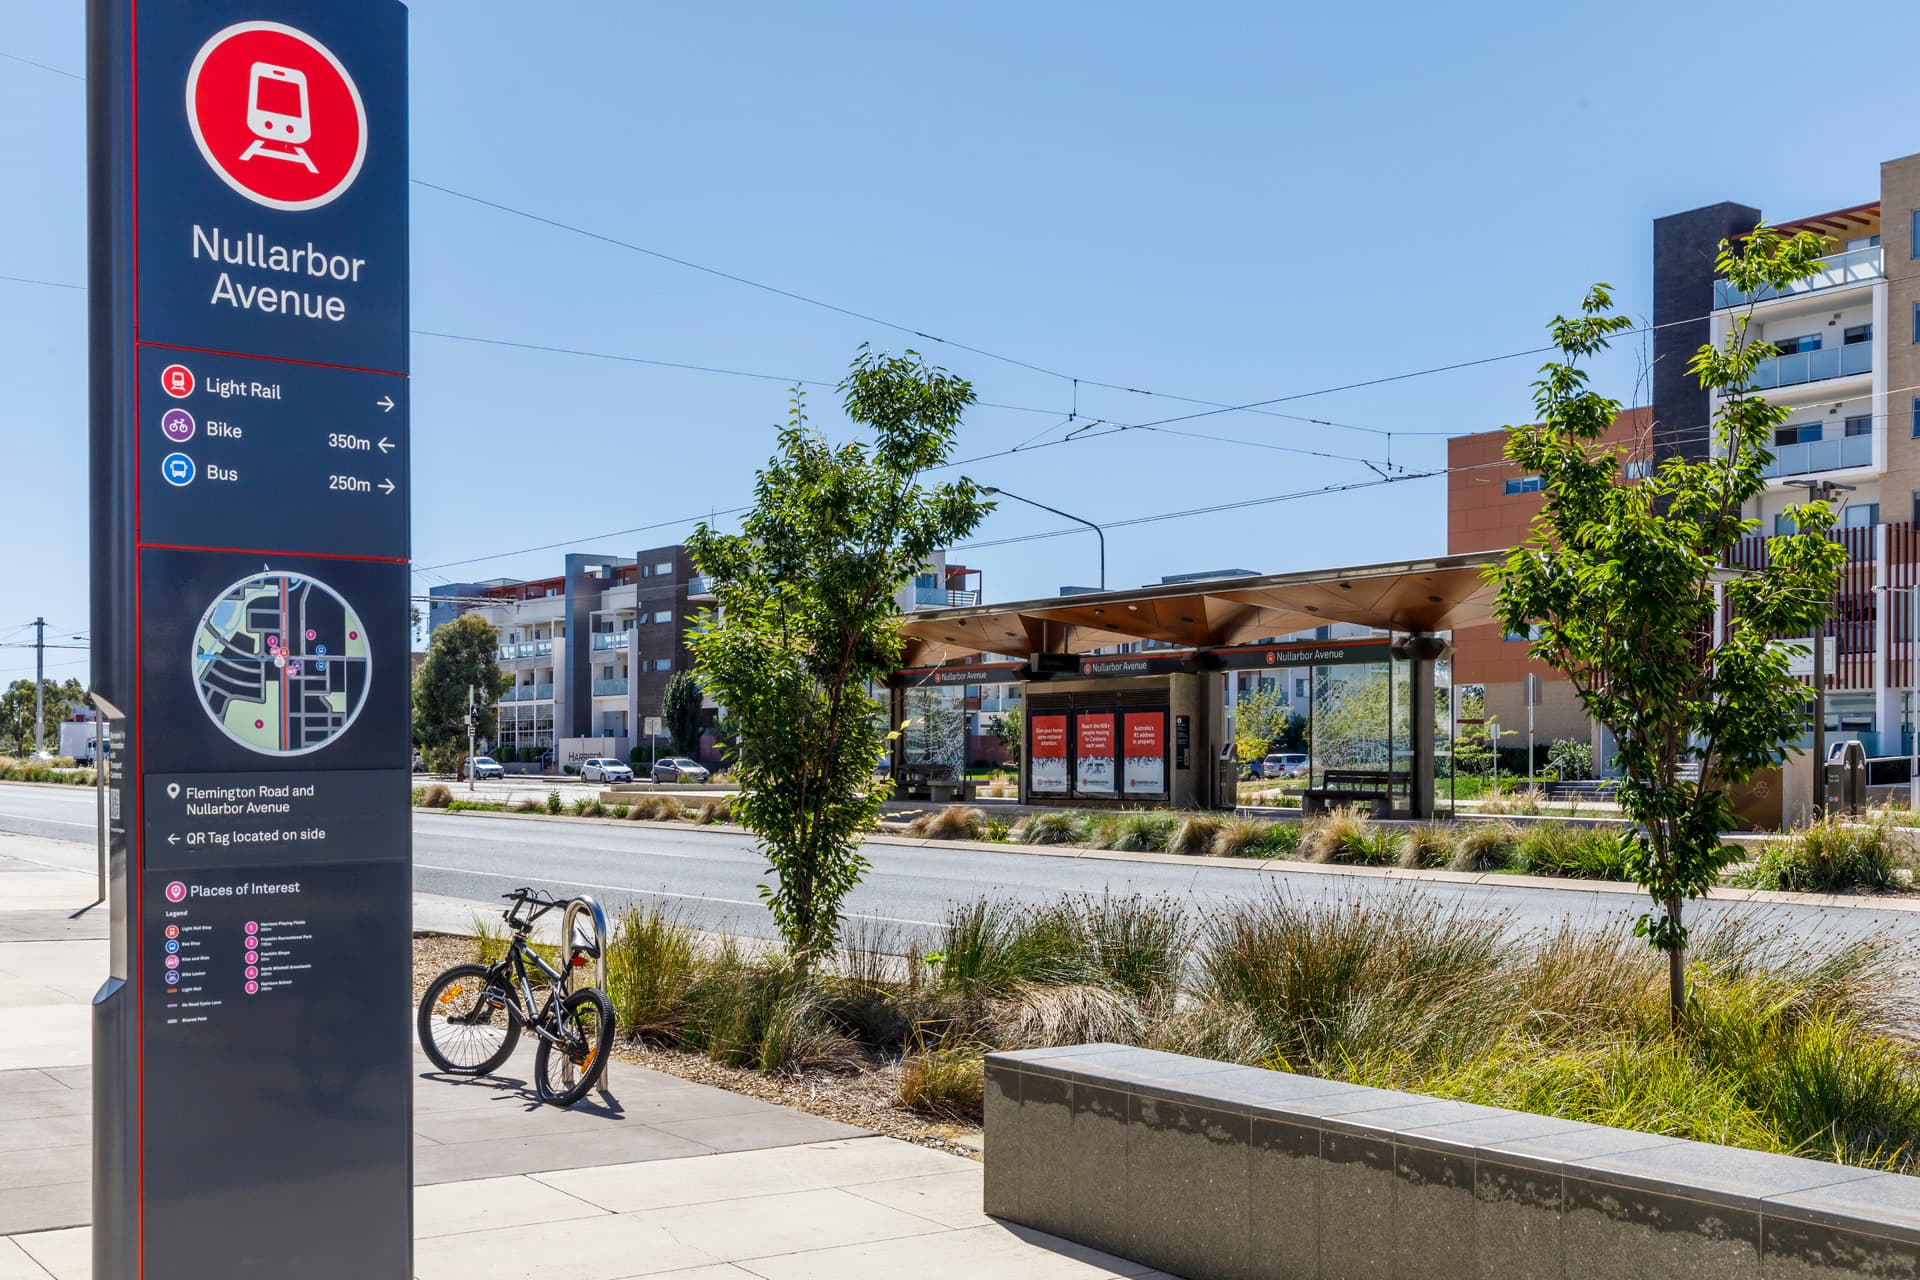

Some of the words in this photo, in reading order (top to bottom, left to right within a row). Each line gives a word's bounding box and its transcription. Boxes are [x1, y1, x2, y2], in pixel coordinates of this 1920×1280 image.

[193, 224, 365, 282] Nullarbor
[210, 272, 346, 322] Avenue
[206, 377, 247, 397] Light
[251, 382, 282, 400] Rail
[207, 421, 243, 439] Bike
[328, 433, 371, 451] 350m
[207, 465, 239, 482] Bus
[328, 475, 371, 492] 250m
[1276, 650, 1313, 662] Nullarbor
[1314, 649, 1344, 660] Avenue
[1092, 662, 1122, 673] Nullarbor
[1123, 661, 1147, 671] Avenue
[941, 672, 966, 682] Nullarbor
[967, 671, 987, 681] Avenue
[186, 786, 256, 801] Flemington
[259, 785, 289, 798] Road
[292, 785, 315, 797] and
[186, 802, 244, 816] Nullarbor
[246, 801, 290, 814] Avenue
[186, 832, 206, 845] QR
[208, 831, 230, 846] Tag
[233, 829, 280, 844] located
[282, 830, 297, 842] on
[300, 828, 326, 841] side
[190, 884, 233, 897] Places
[235, 883, 249, 895] of
[251, 881, 301, 895] Interest
[165, 909, 188, 918] Legend
